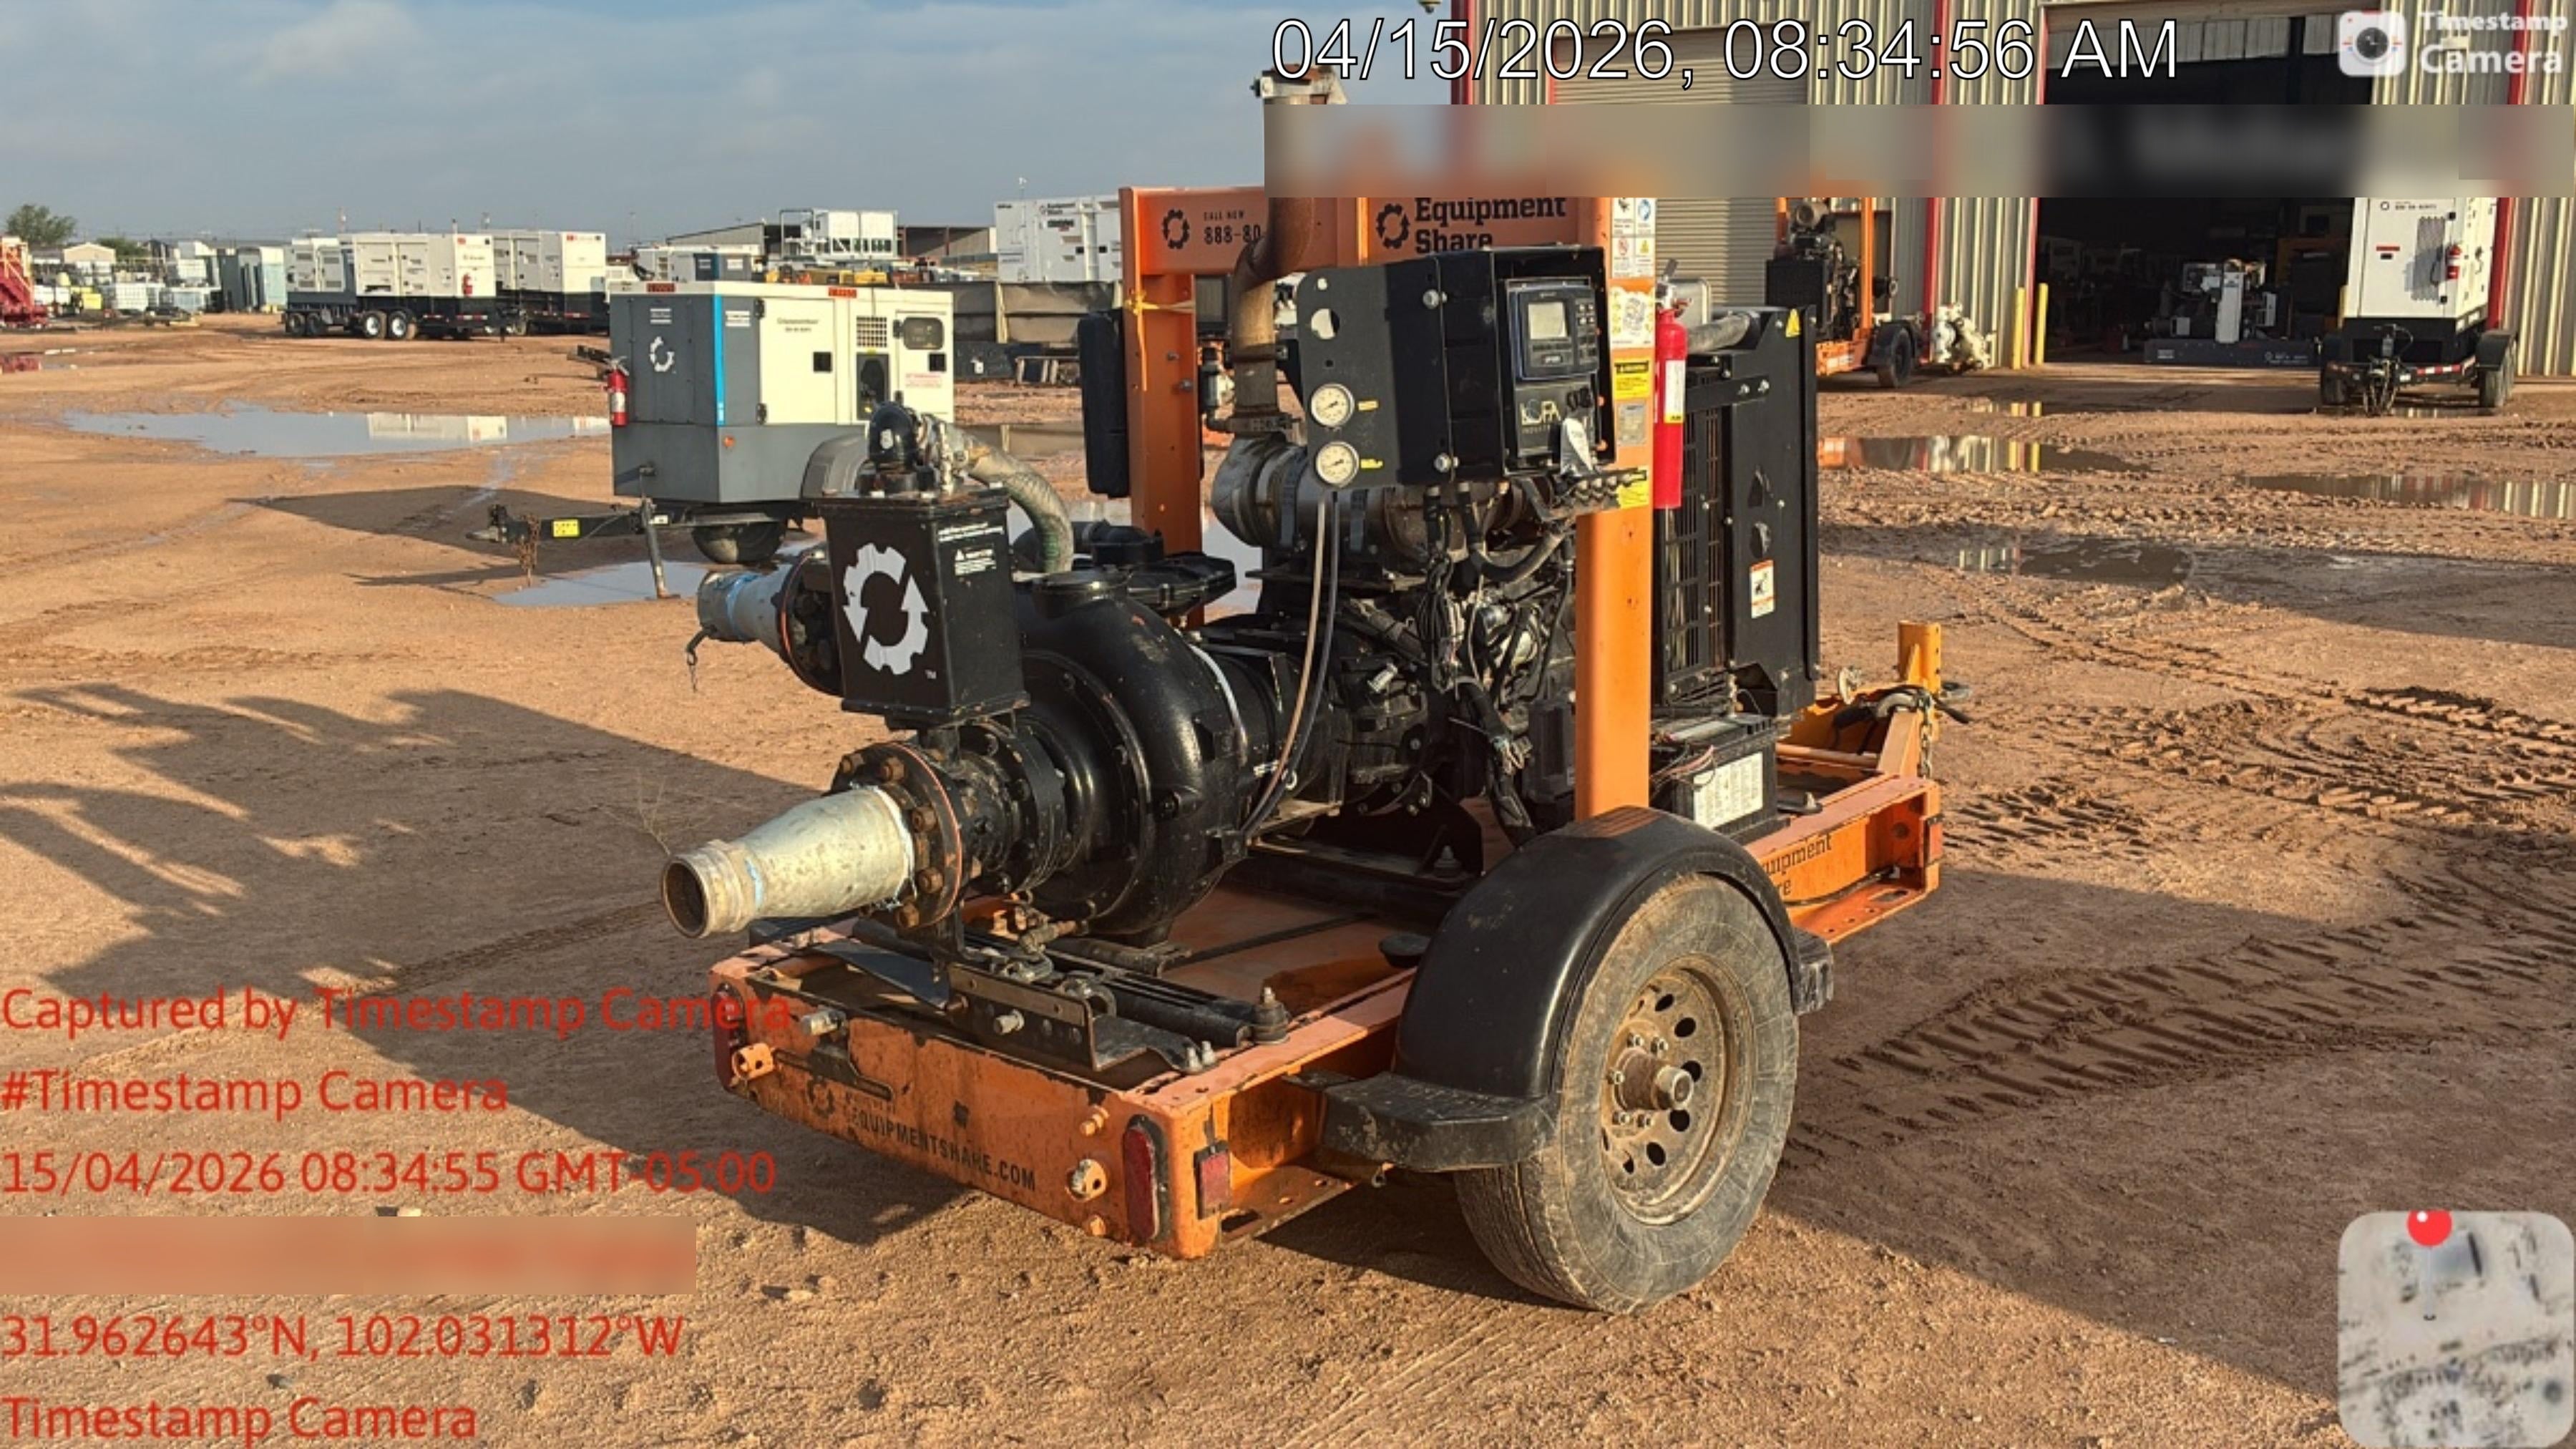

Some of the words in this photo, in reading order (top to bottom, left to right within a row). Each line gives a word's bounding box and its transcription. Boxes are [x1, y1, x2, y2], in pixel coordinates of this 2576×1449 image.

[1414, 197, 1566, 228] Equipment
[1415, 228, 1493, 254] Share
[1761, 832, 1832, 876] uipment
